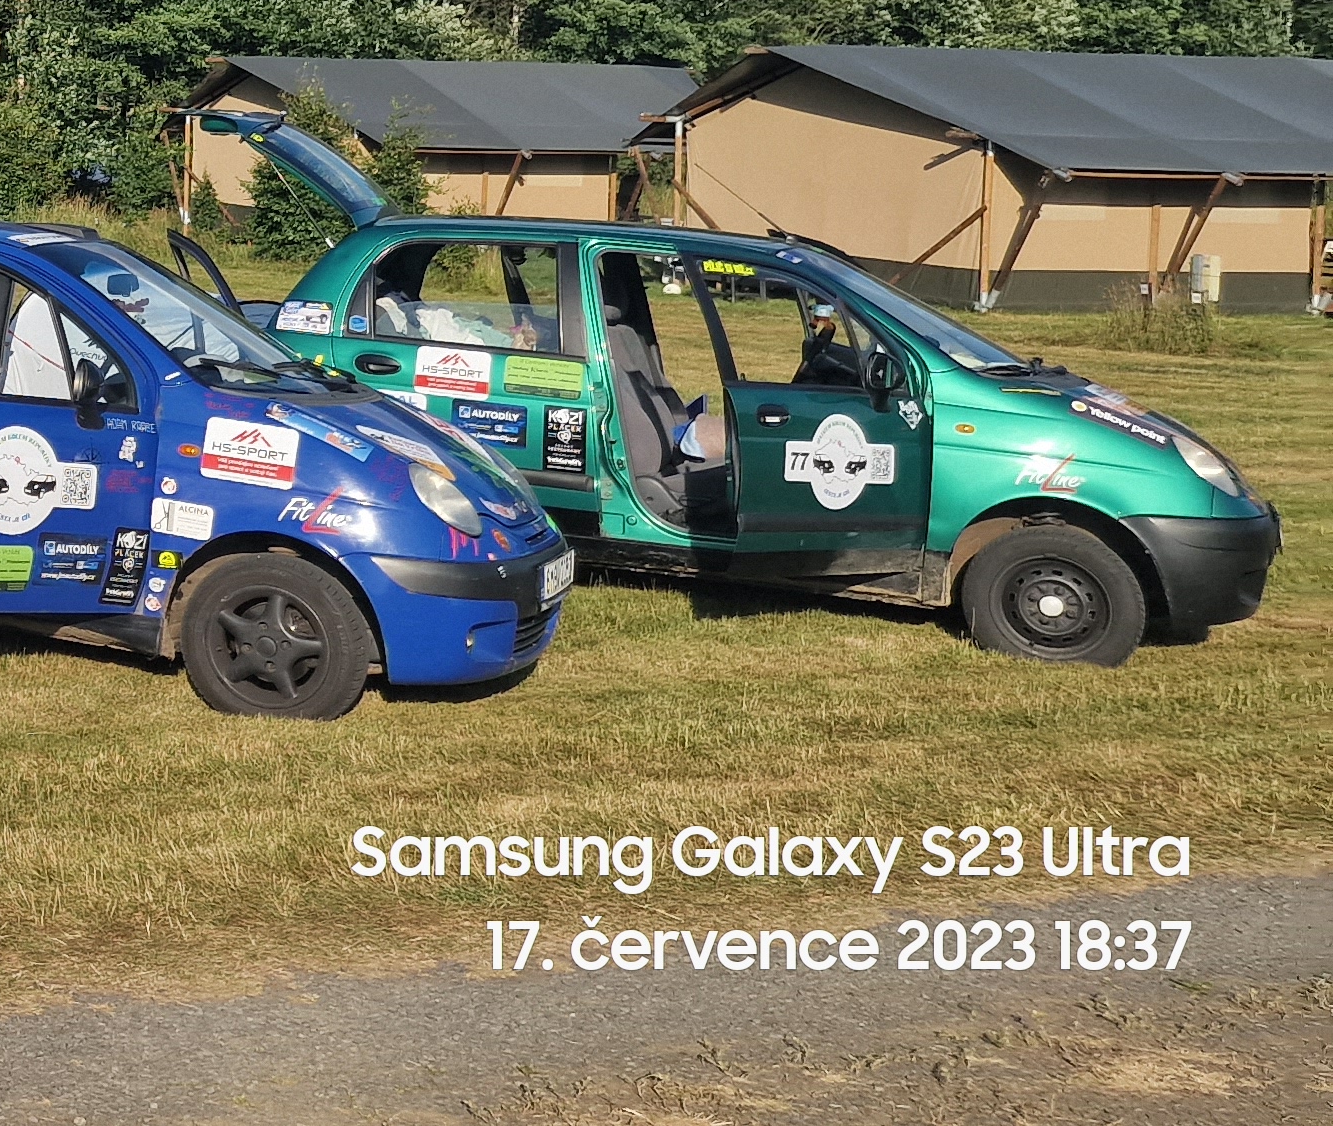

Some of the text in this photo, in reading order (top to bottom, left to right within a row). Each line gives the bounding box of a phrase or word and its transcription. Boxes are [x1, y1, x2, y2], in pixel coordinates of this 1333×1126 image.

[422, 365, 484, 379] HS-SPORT
[471, 408, 520, 422] AUTODÍLY
[1089, 405, 1167, 445] Yellow point
[211, 441, 289, 462] HS-SPORT
[790, 451, 810, 471] 77
[178, 505, 209, 516] ALCINA
[55, 543, 100, 555] AUTODÍLY
